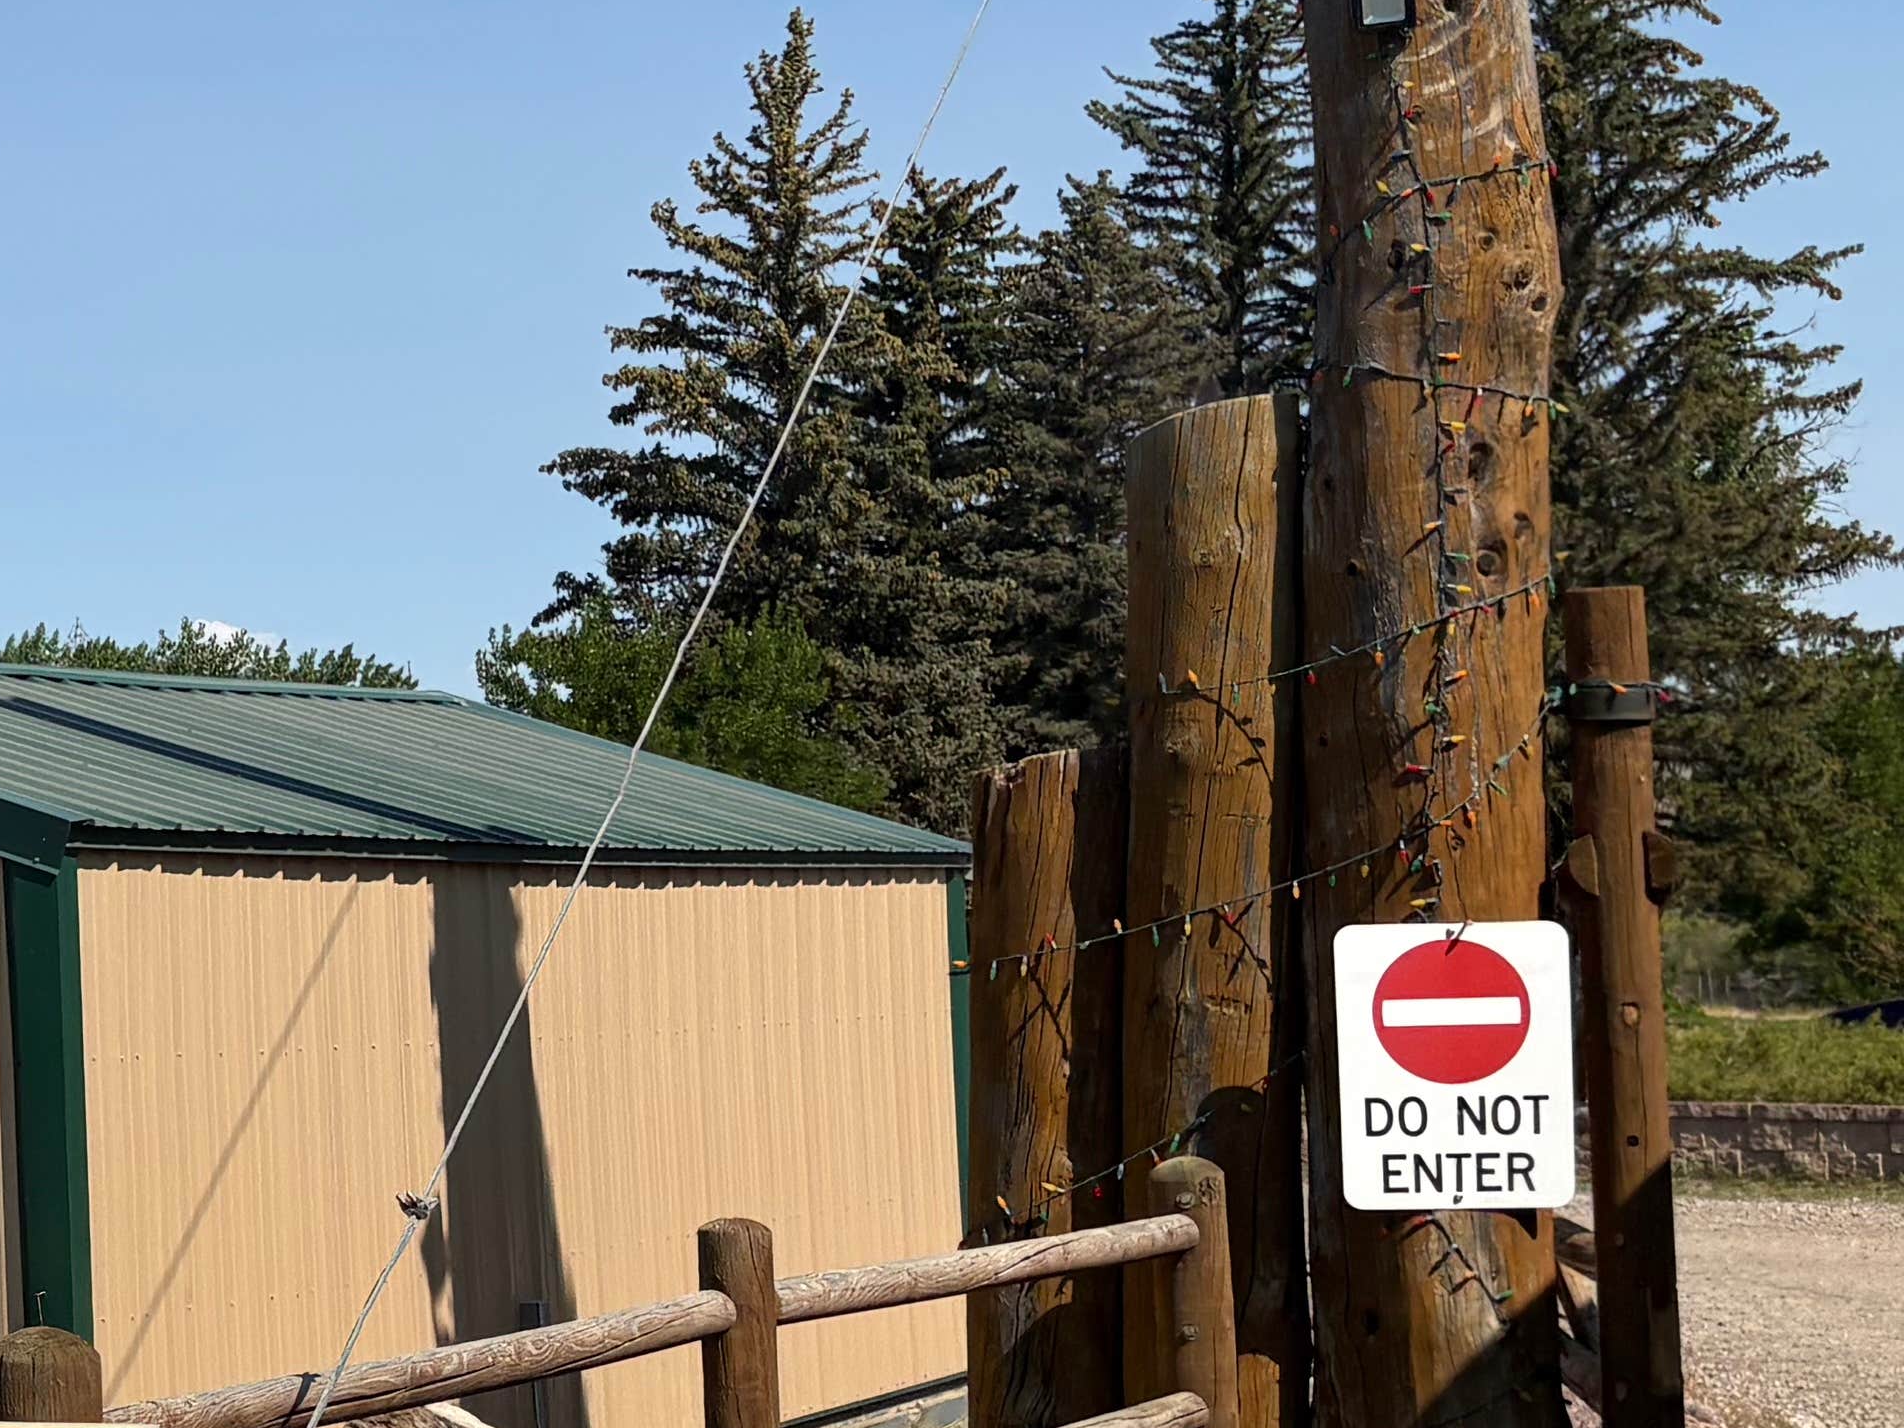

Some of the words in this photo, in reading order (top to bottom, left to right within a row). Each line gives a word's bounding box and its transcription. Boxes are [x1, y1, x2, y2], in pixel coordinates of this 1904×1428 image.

[1364, 1095, 1428, 1137] DO
[1457, 1094, 1549, 1136] NOT
[1382, 1152, 1536, 1193] ENTER
